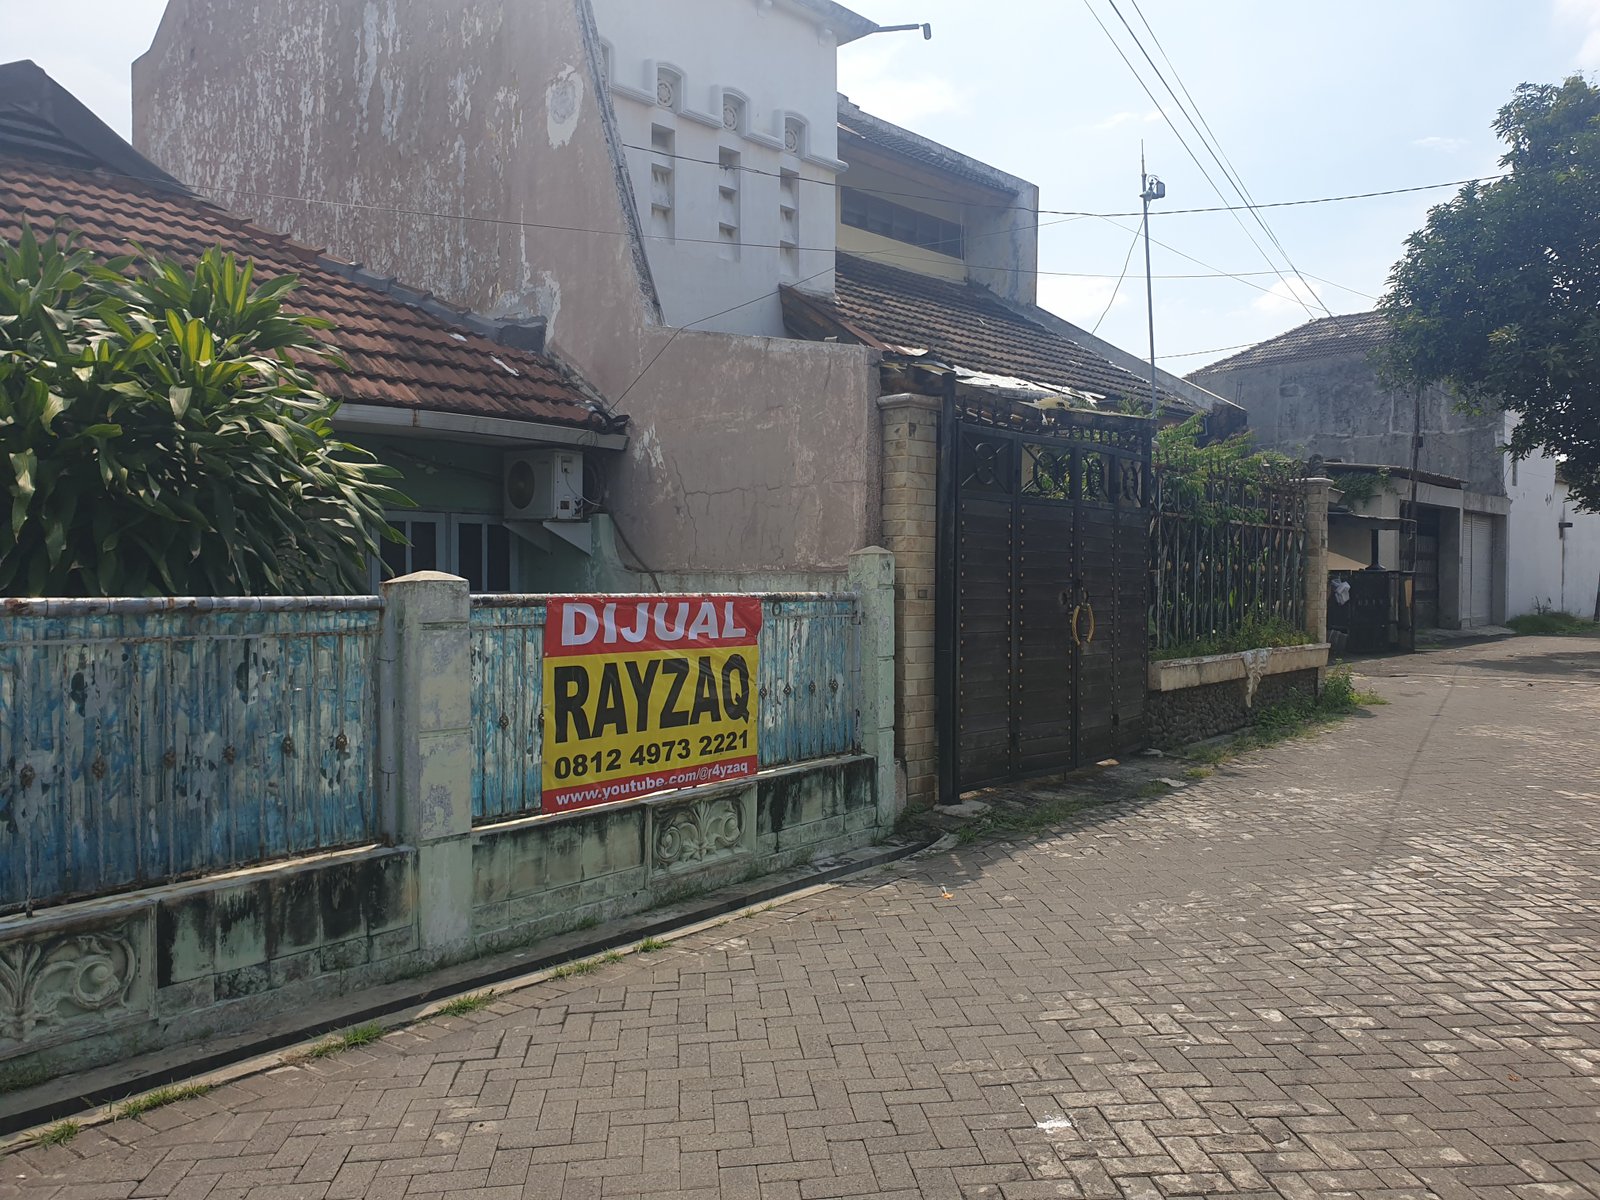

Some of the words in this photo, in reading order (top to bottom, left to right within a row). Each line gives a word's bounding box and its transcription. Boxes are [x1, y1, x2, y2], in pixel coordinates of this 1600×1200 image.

[561, 601, 747, 646] DIJUAL
[553, 653, 750, 744] RAYZAQ
[554, 748, 622, 779] 0812
[629, 738, 691, 766] 4973
[698, 729, 748, 757] 2221
[556, 761, 748, 806] www.youtube.com/@r4yzaq
